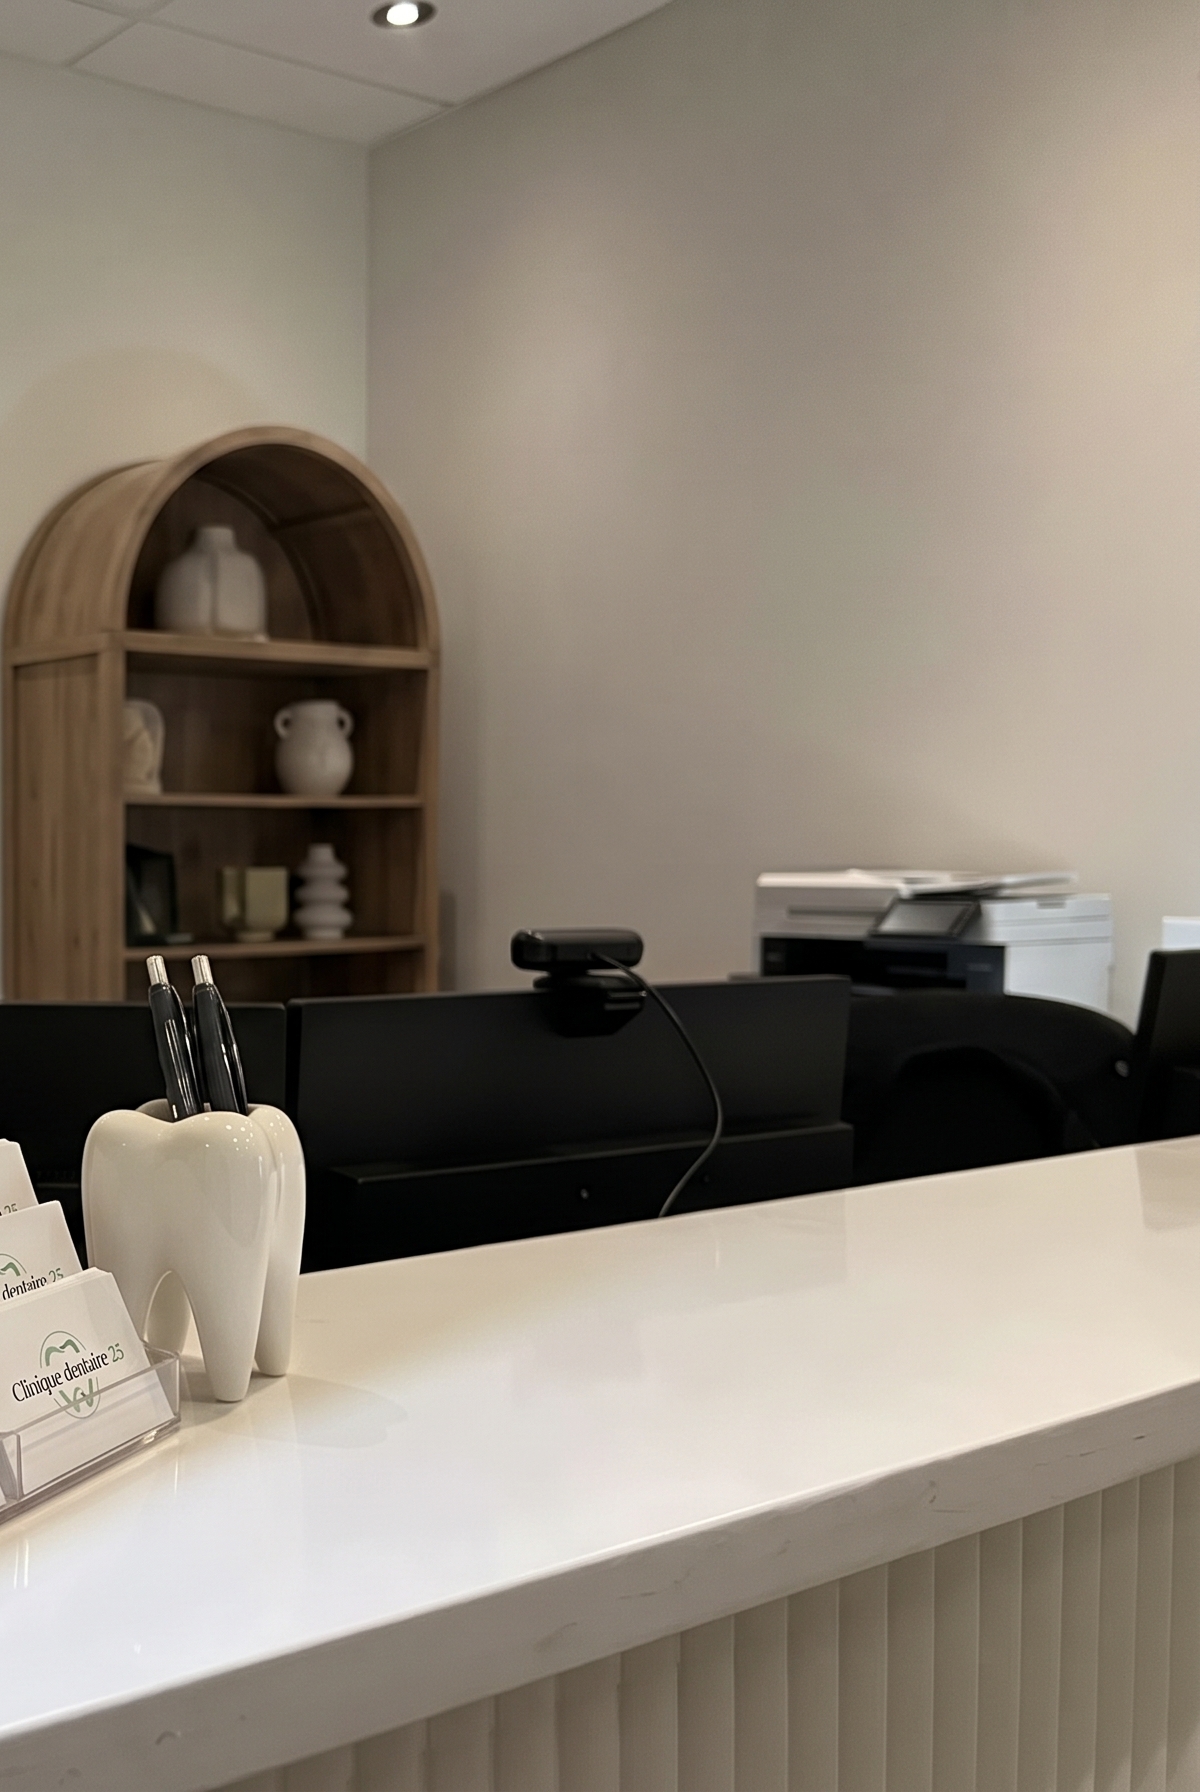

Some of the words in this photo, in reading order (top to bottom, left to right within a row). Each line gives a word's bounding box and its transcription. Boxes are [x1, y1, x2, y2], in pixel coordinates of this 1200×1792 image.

[2, 1275, 47, 1301] dentaire
[12, 1372, 64, 1402] Clinique
[63, 1352, 109, 1382] dentaire
[107, 1343, 124, 1363] 25
